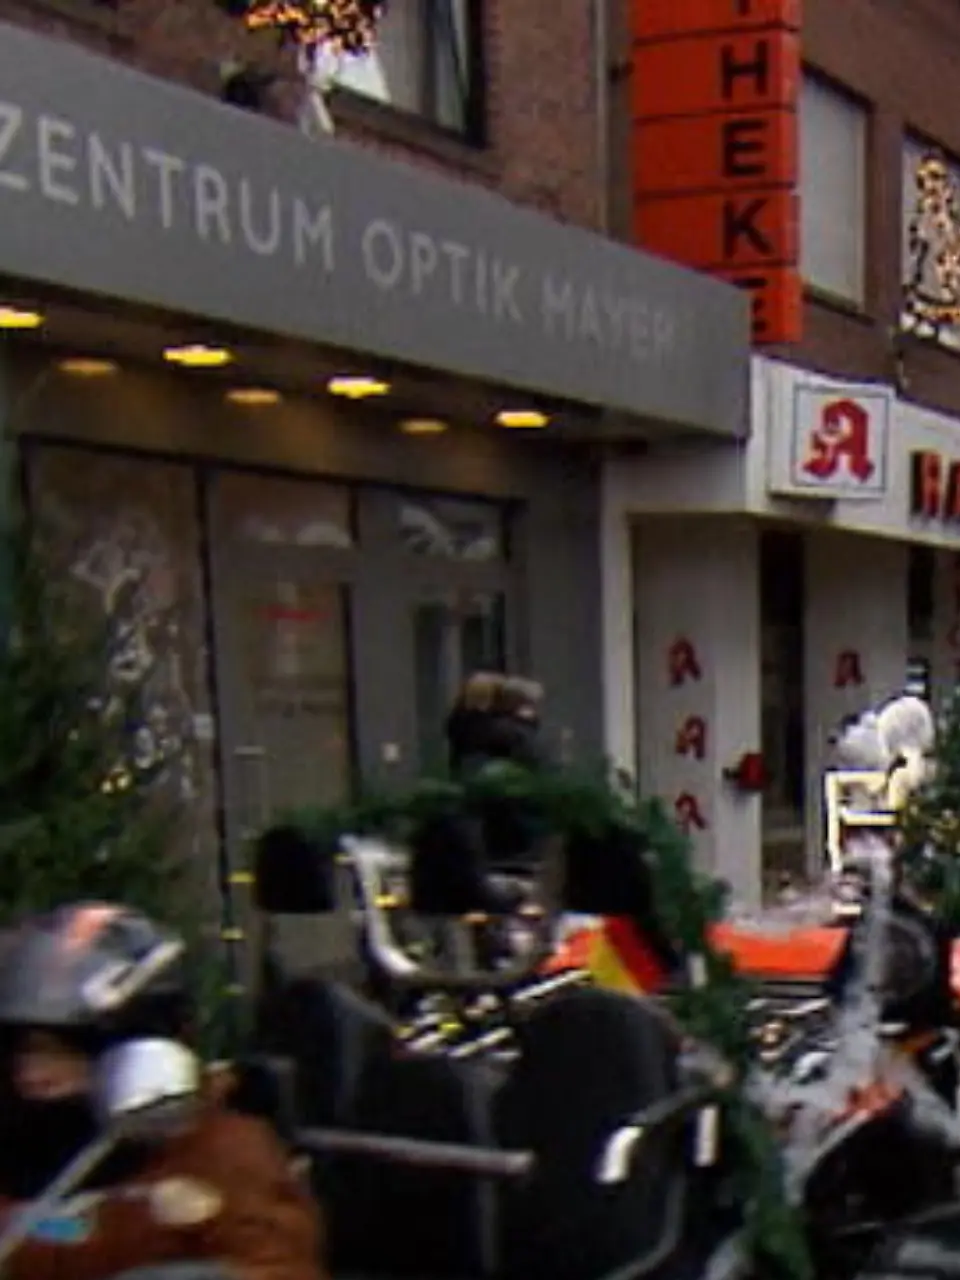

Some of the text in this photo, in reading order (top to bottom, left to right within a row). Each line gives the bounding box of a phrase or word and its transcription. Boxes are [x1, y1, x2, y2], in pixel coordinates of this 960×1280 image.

[0, 102, 336, 270] ZENTRUM
[361, 217, 522, 323] OPTIK
[721, 0, 772, 333] HEK
